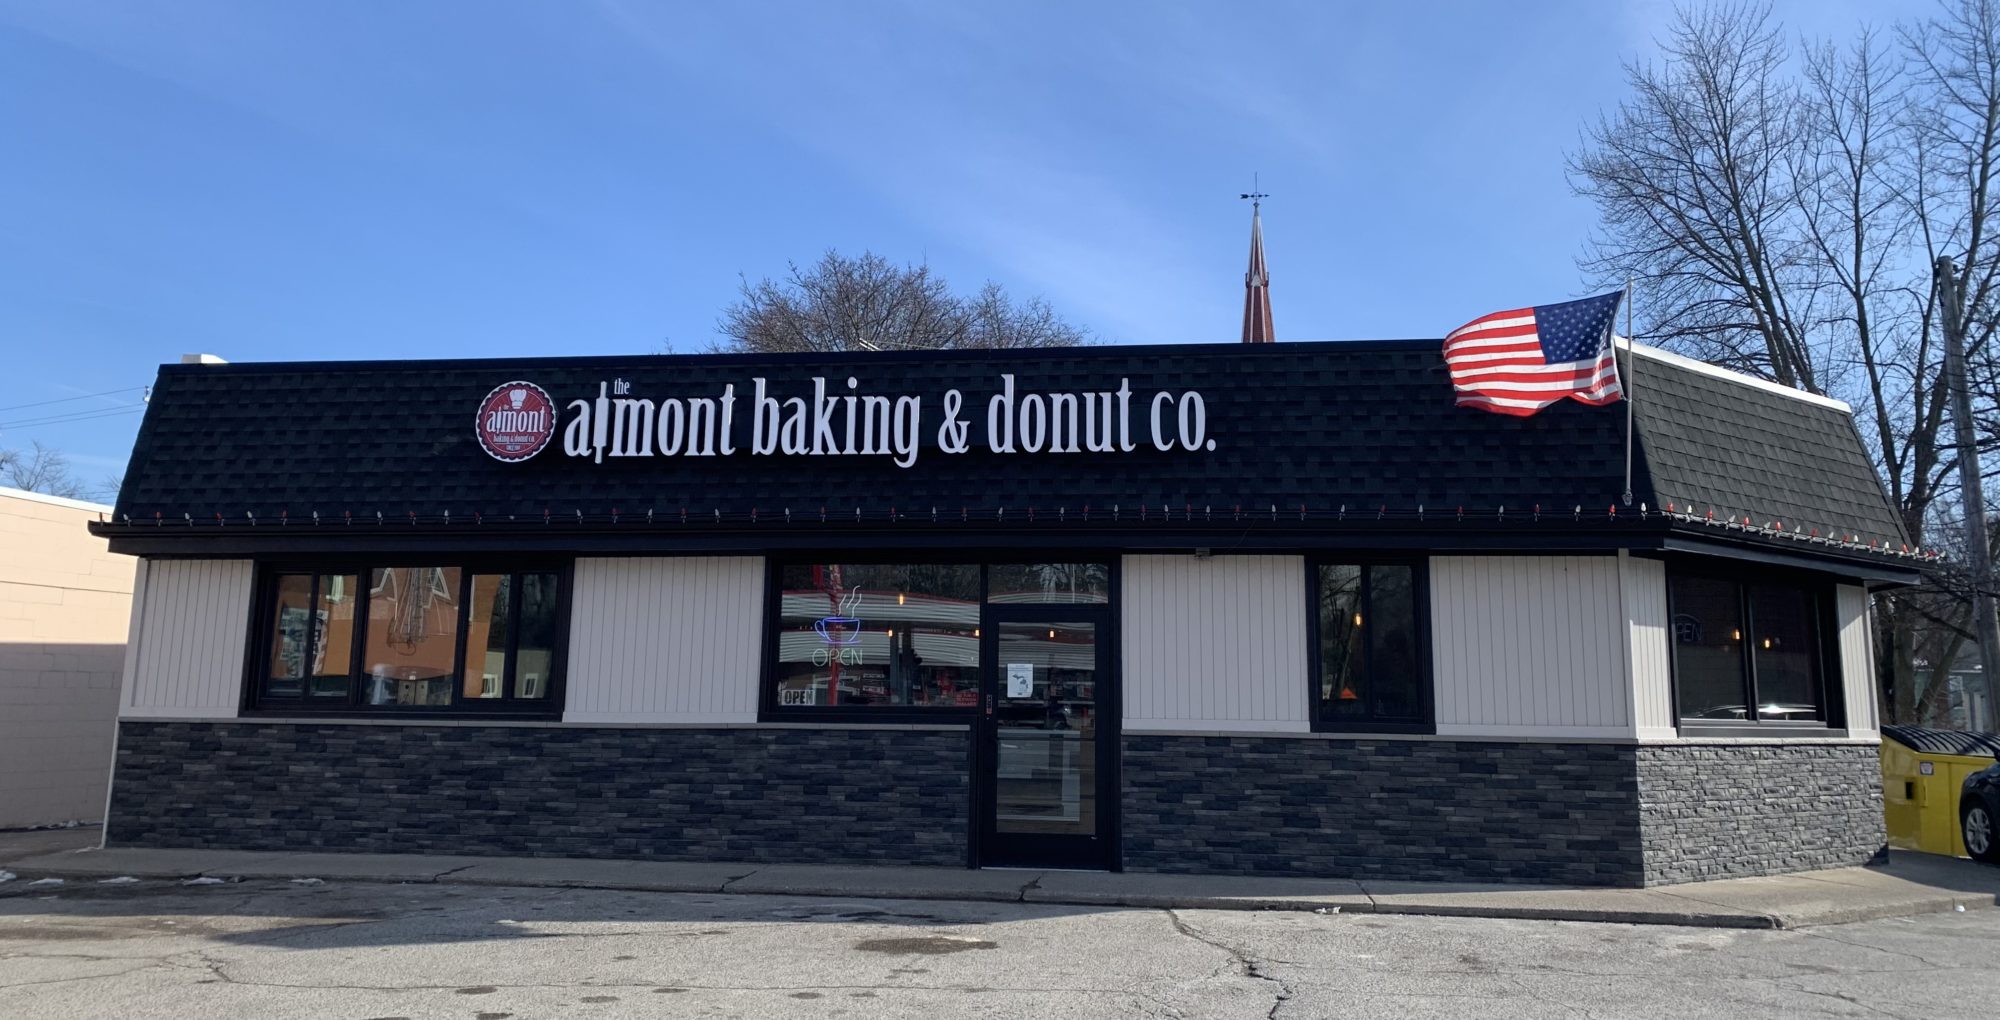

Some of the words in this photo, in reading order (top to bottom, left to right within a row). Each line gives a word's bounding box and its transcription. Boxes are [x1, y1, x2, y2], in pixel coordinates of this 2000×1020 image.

[614, 378, 630, 395] the
[486, 406, 545, 434] almont
[564, 380, 736, 464] almont
[752, 377, 920, 468] baking
[938, 389, 970, 454] &
[988, 374, 1136, 454] donut
[1150, 390, 1217, 452] co.
[1675, 622, 1703, 641] PEN
[812, 648, 863, 667] OPEN
[784, 690, 814, 704] OPEN
